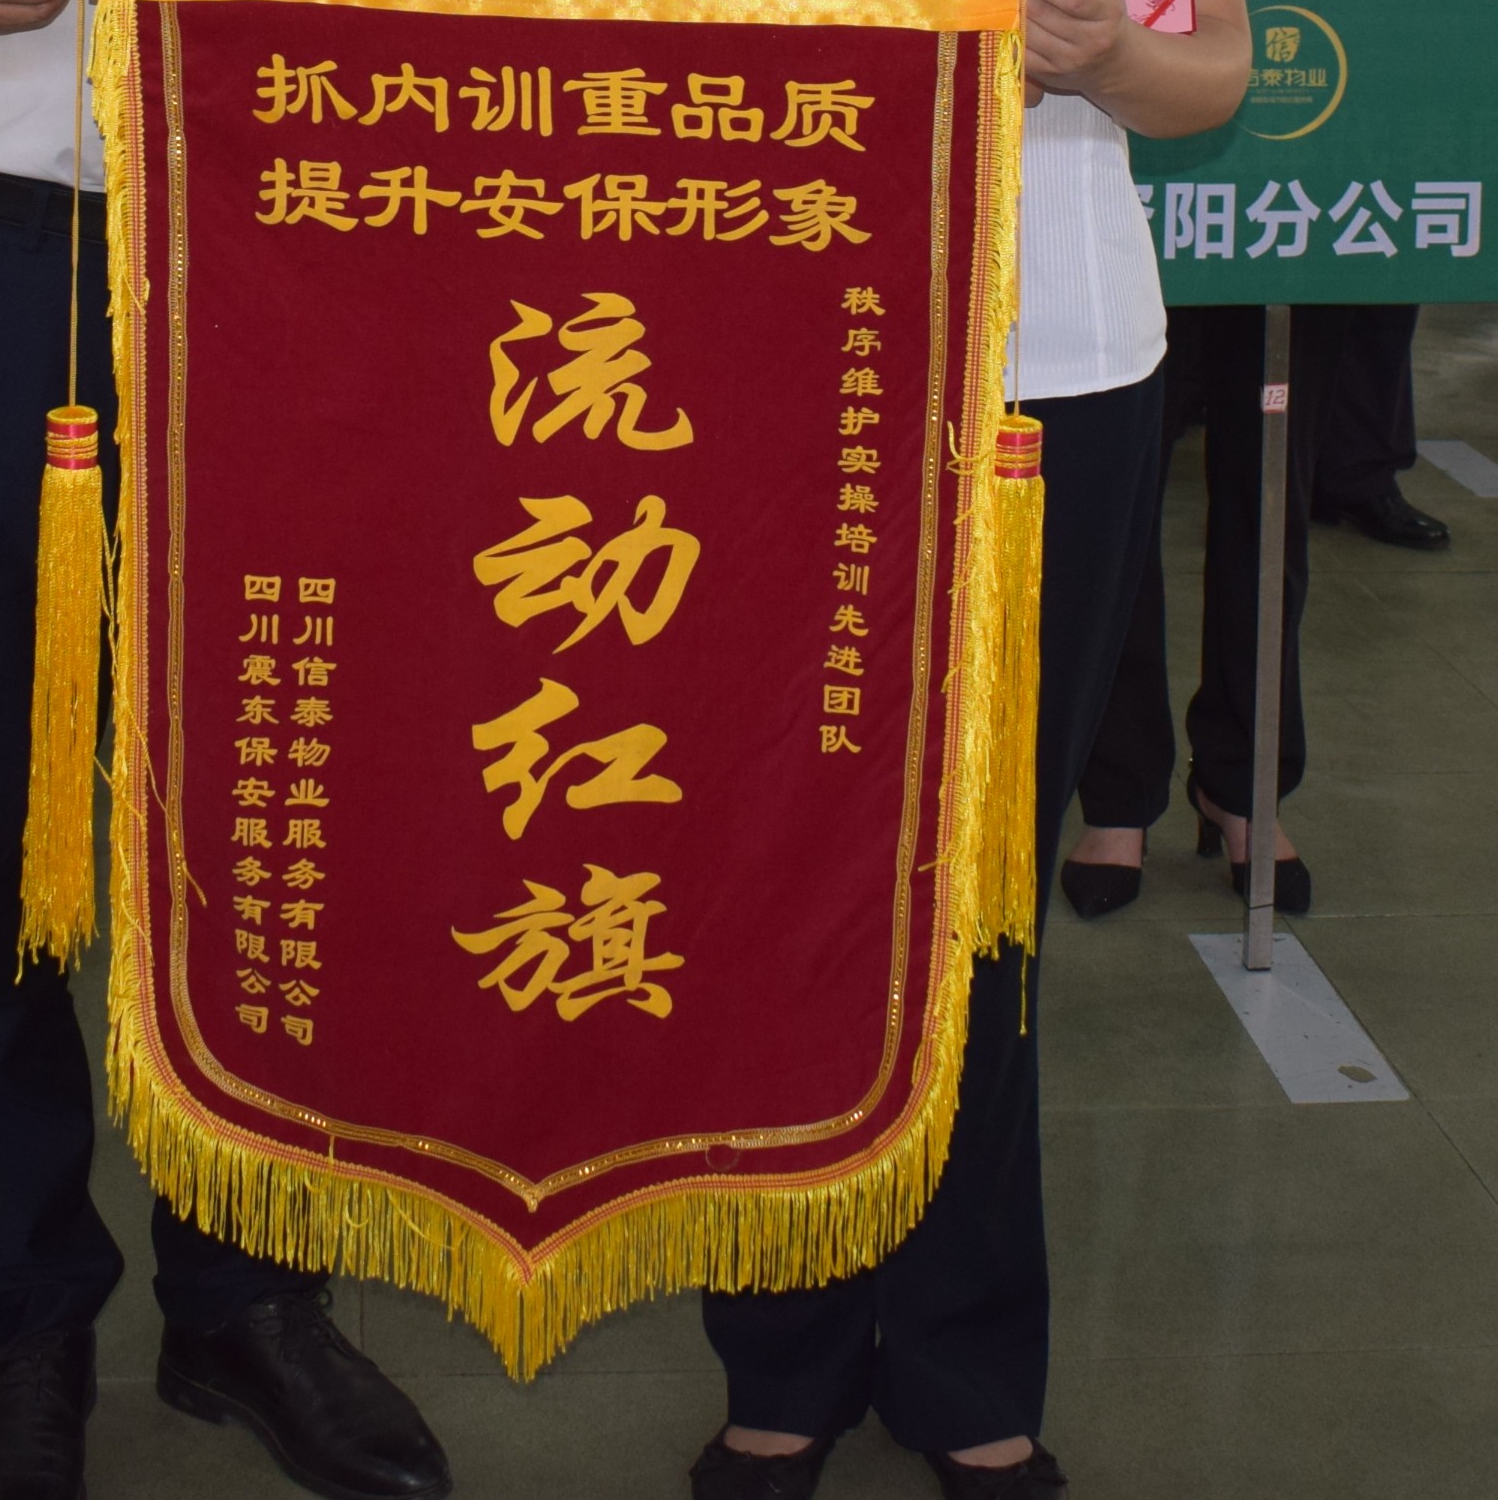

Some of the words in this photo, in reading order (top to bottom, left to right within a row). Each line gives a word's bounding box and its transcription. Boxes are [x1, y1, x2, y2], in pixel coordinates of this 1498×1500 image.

[251, 53, 876, 153] 抓内训重品质
[254, 157, 875, 253] 提升安保形象
[1134, 179, 1483, 259] 阳分公司
[450, 292, 701, 1022] 流动红旗
[819, 286, 886, 754] 秩序维护实操培训先进团队
[230, 574, 282, 1034] 四川震东保安服务有限公司
[279, 576, 337, 1046] 四川信泰物业服务有限公司
